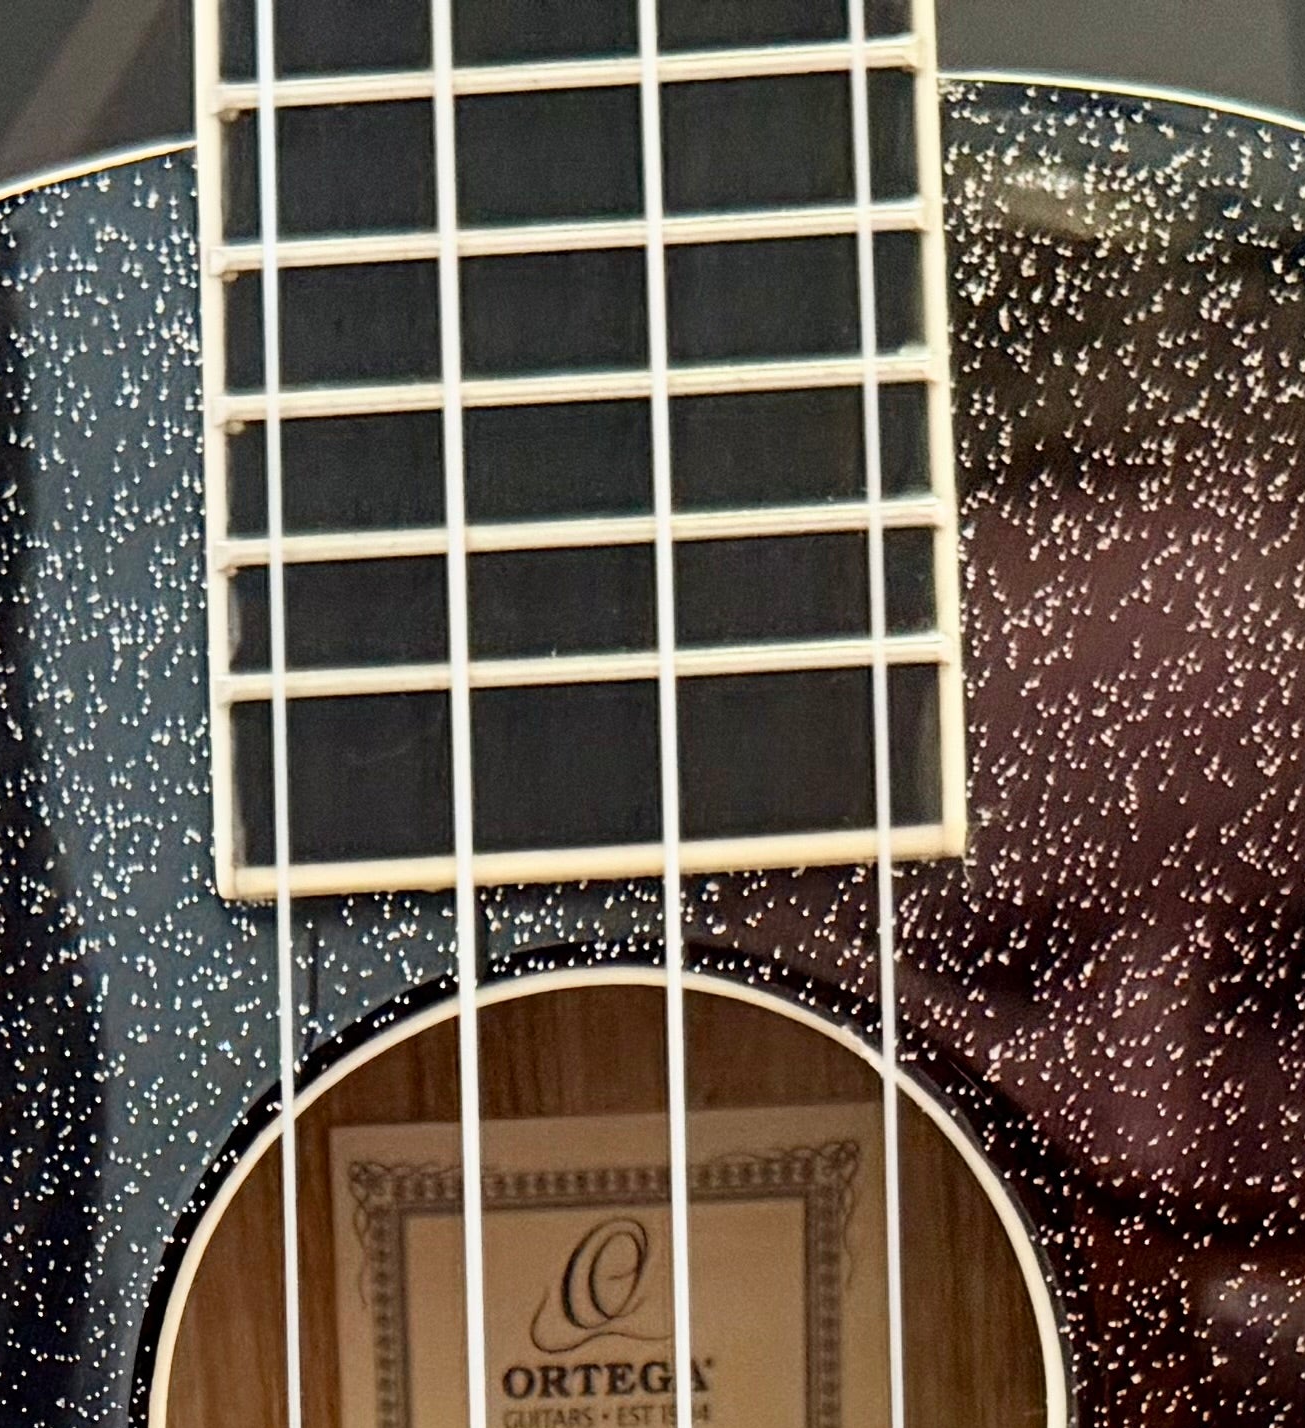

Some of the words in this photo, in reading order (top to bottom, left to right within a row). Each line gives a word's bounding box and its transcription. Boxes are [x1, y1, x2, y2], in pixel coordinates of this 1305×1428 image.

[502, 1360, 708, 1398] ORTEGA
[617, 1405, 653, 1427] EST
[661, 1403, 711, 1426] 194
